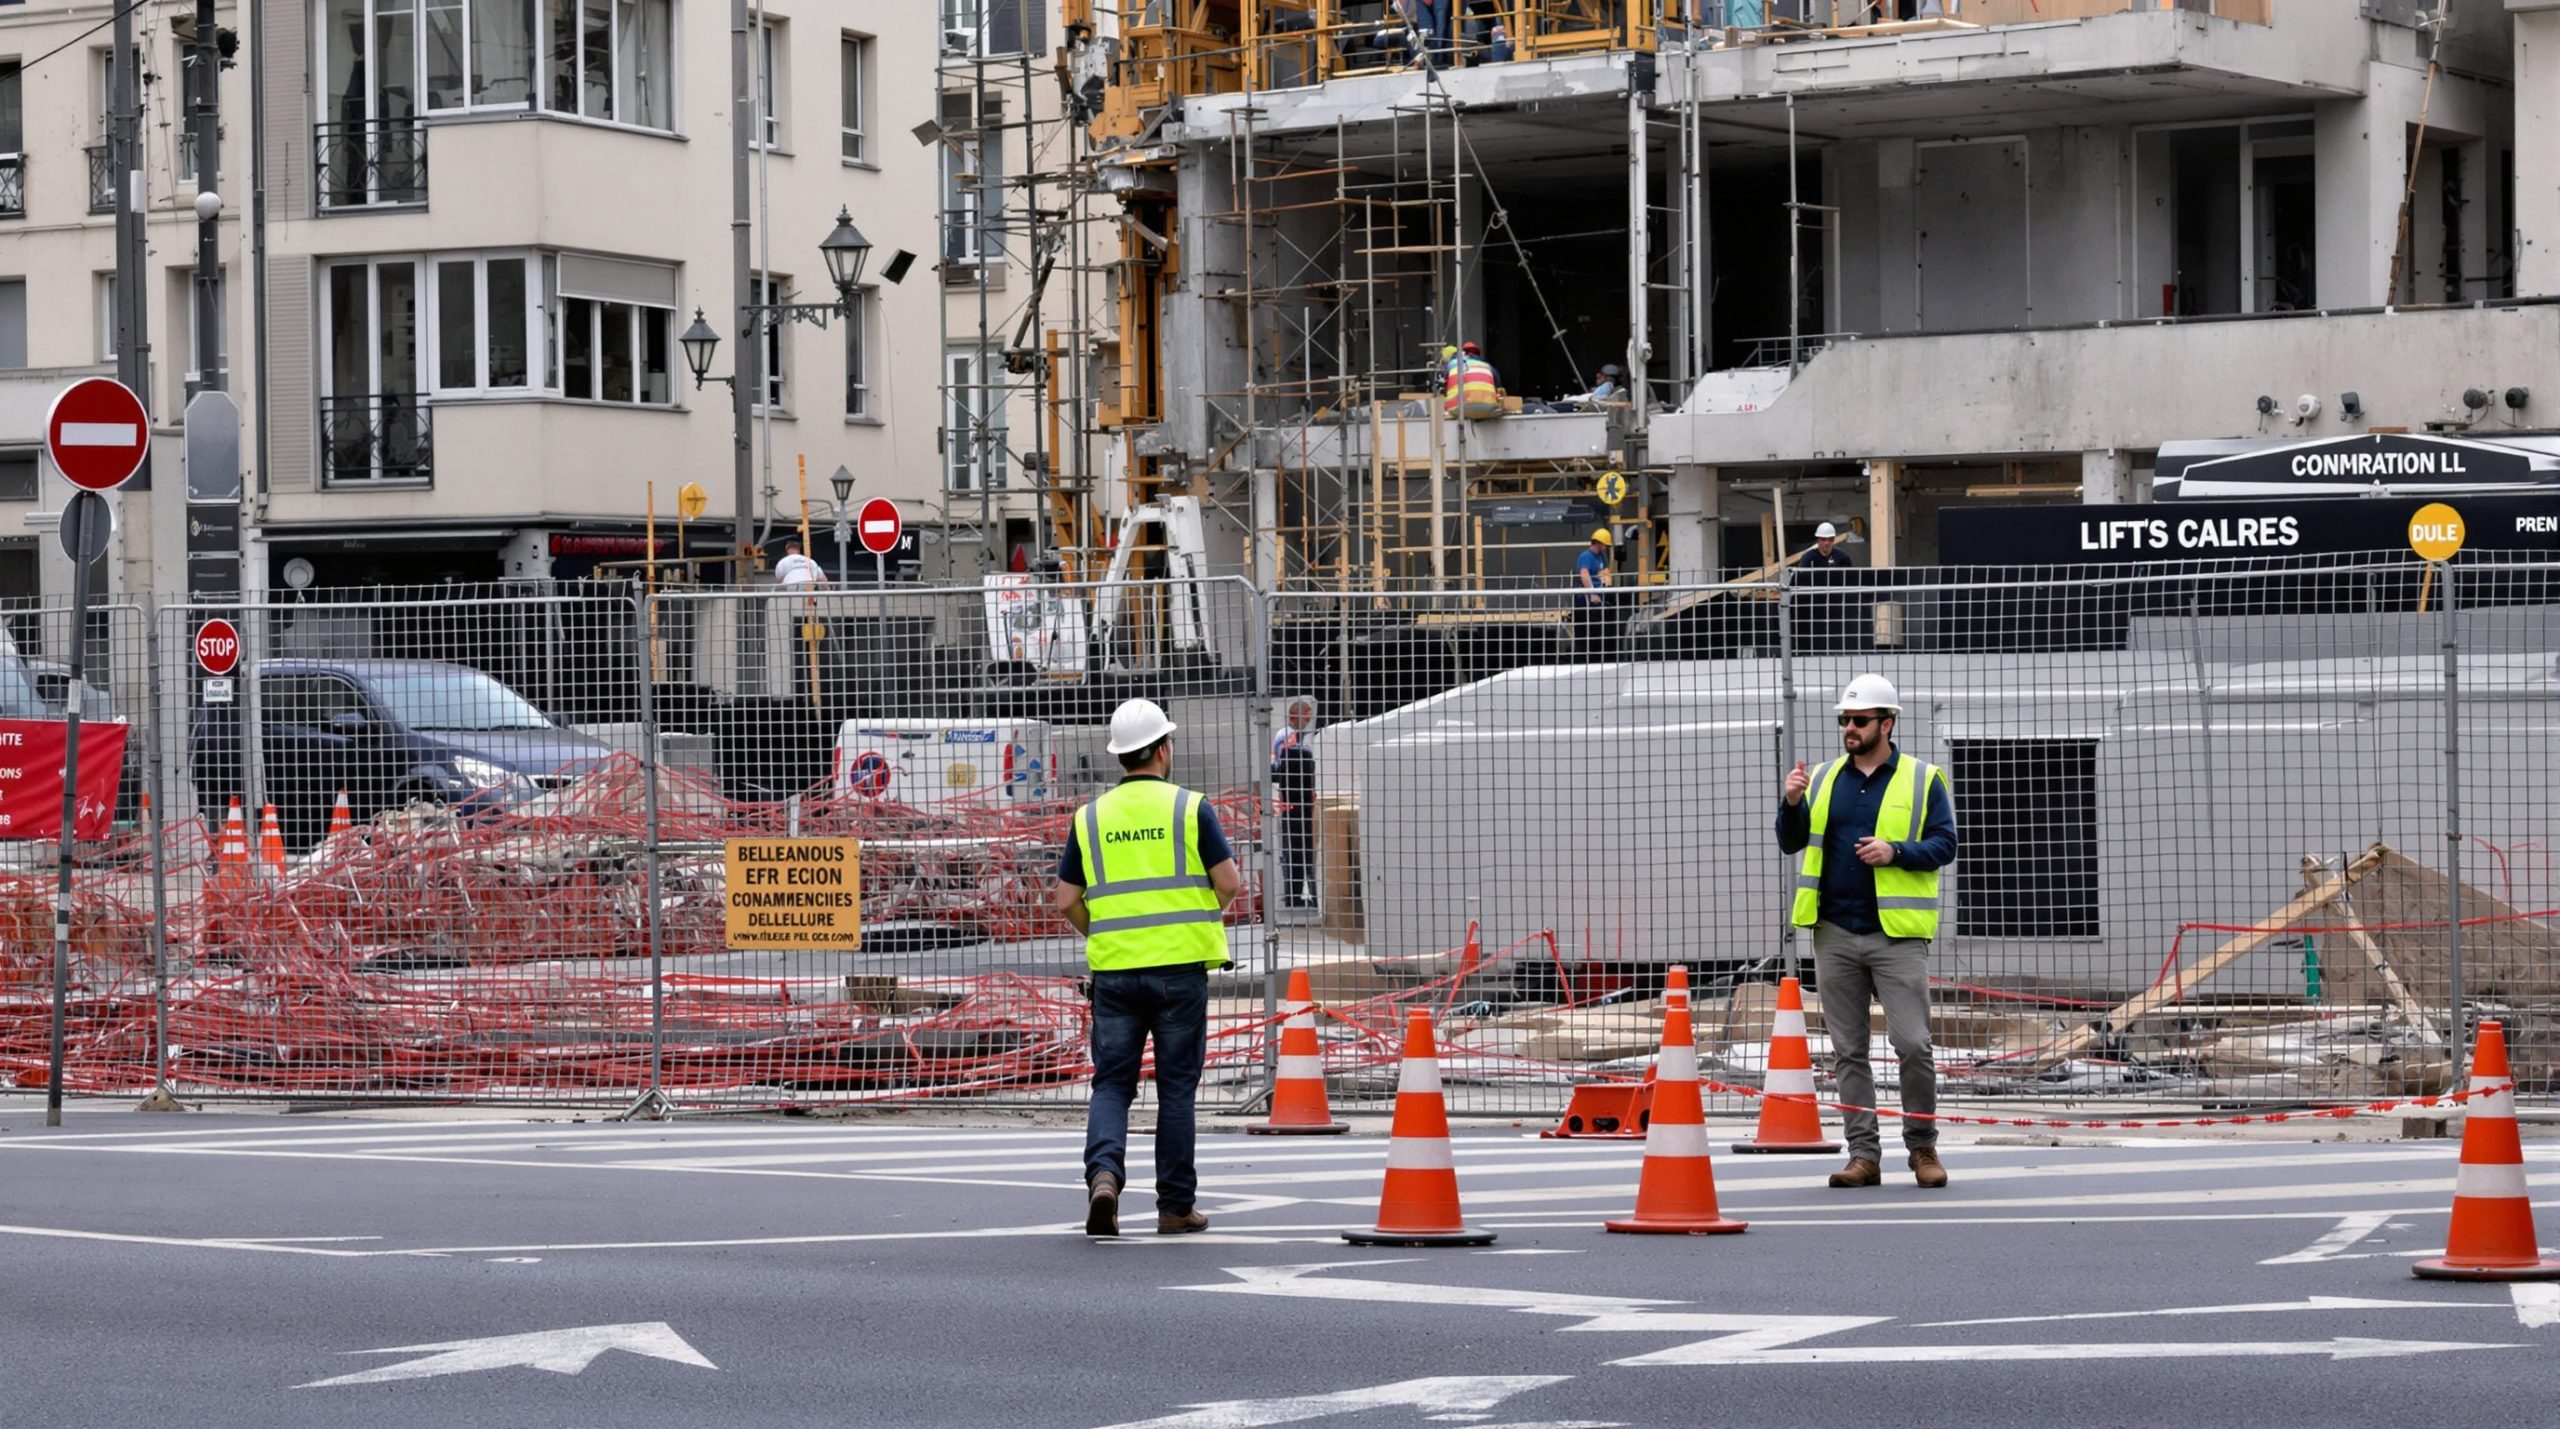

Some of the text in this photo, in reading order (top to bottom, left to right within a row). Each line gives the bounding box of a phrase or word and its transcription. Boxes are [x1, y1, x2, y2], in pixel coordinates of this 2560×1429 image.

[2441, 452, 2466, 473] LL
[2177, 515, 2300, 549] CALRES
[2412, 523, 2458, 543] DULE
[2515, 516, 2558, 533] PREN
[200, 637, 235, 657] STOP
[738, 845, 844, 862] BELLEANOUS
[746, 867, 842, 885] EFR ECION
[748, 912, 835, 927] DELLELLURE
